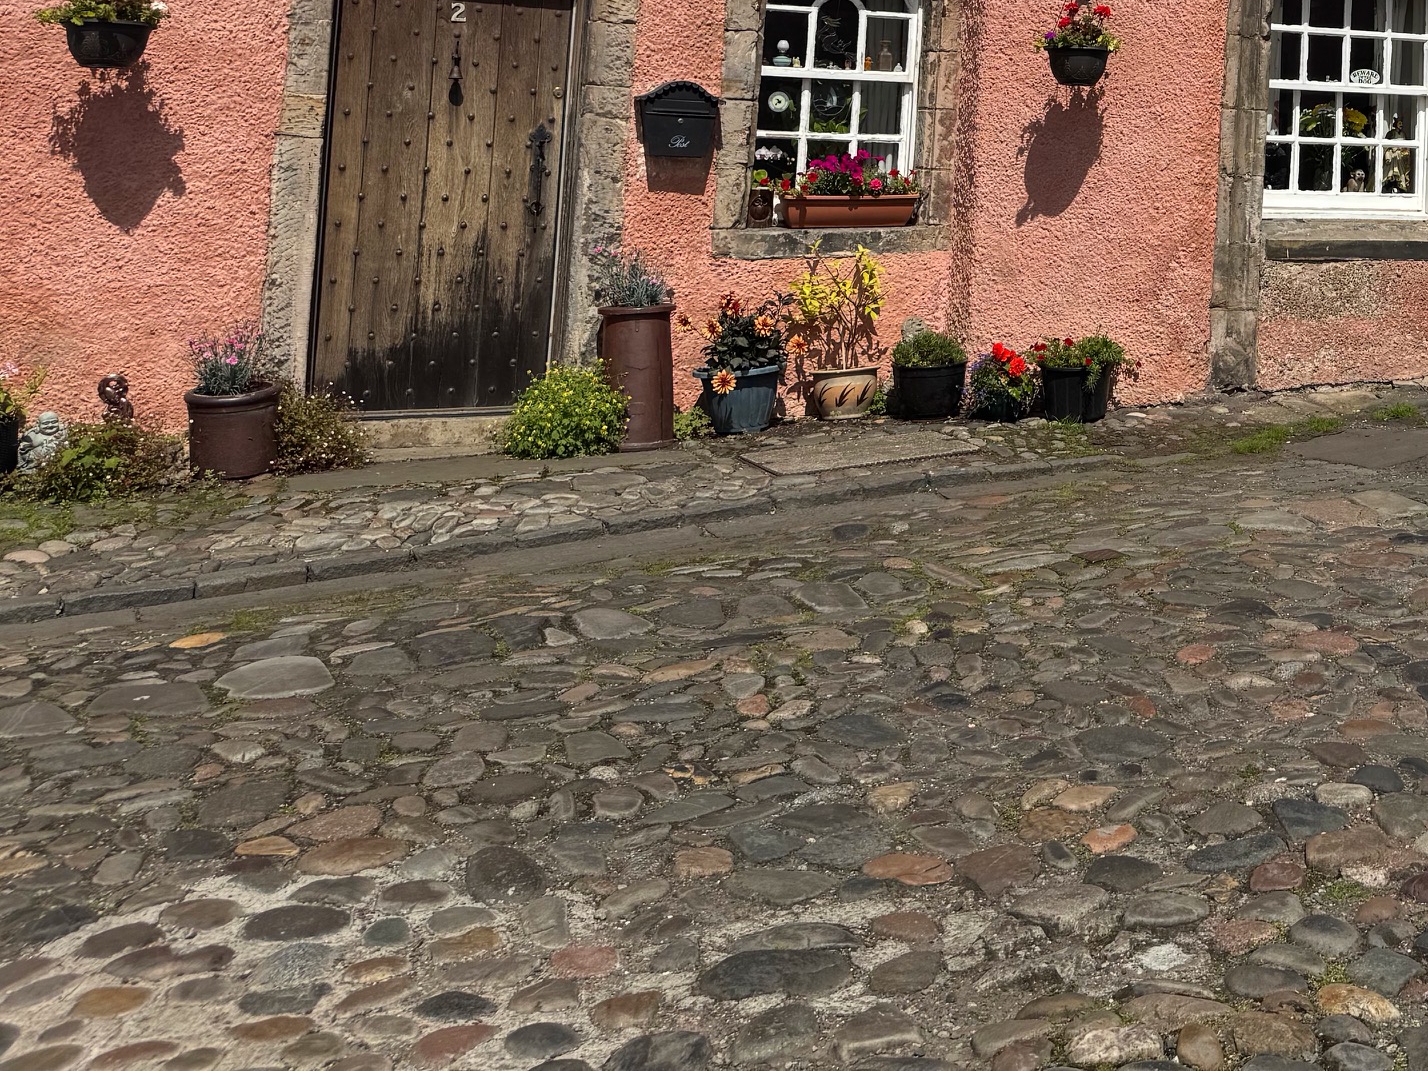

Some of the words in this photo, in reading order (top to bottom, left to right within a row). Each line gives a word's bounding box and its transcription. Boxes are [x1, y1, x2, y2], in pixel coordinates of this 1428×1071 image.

[450, 2, 467, 22] 2
[1352, 70, 1379, 79] BEWARE
[668, 134, 691, 148] Post
